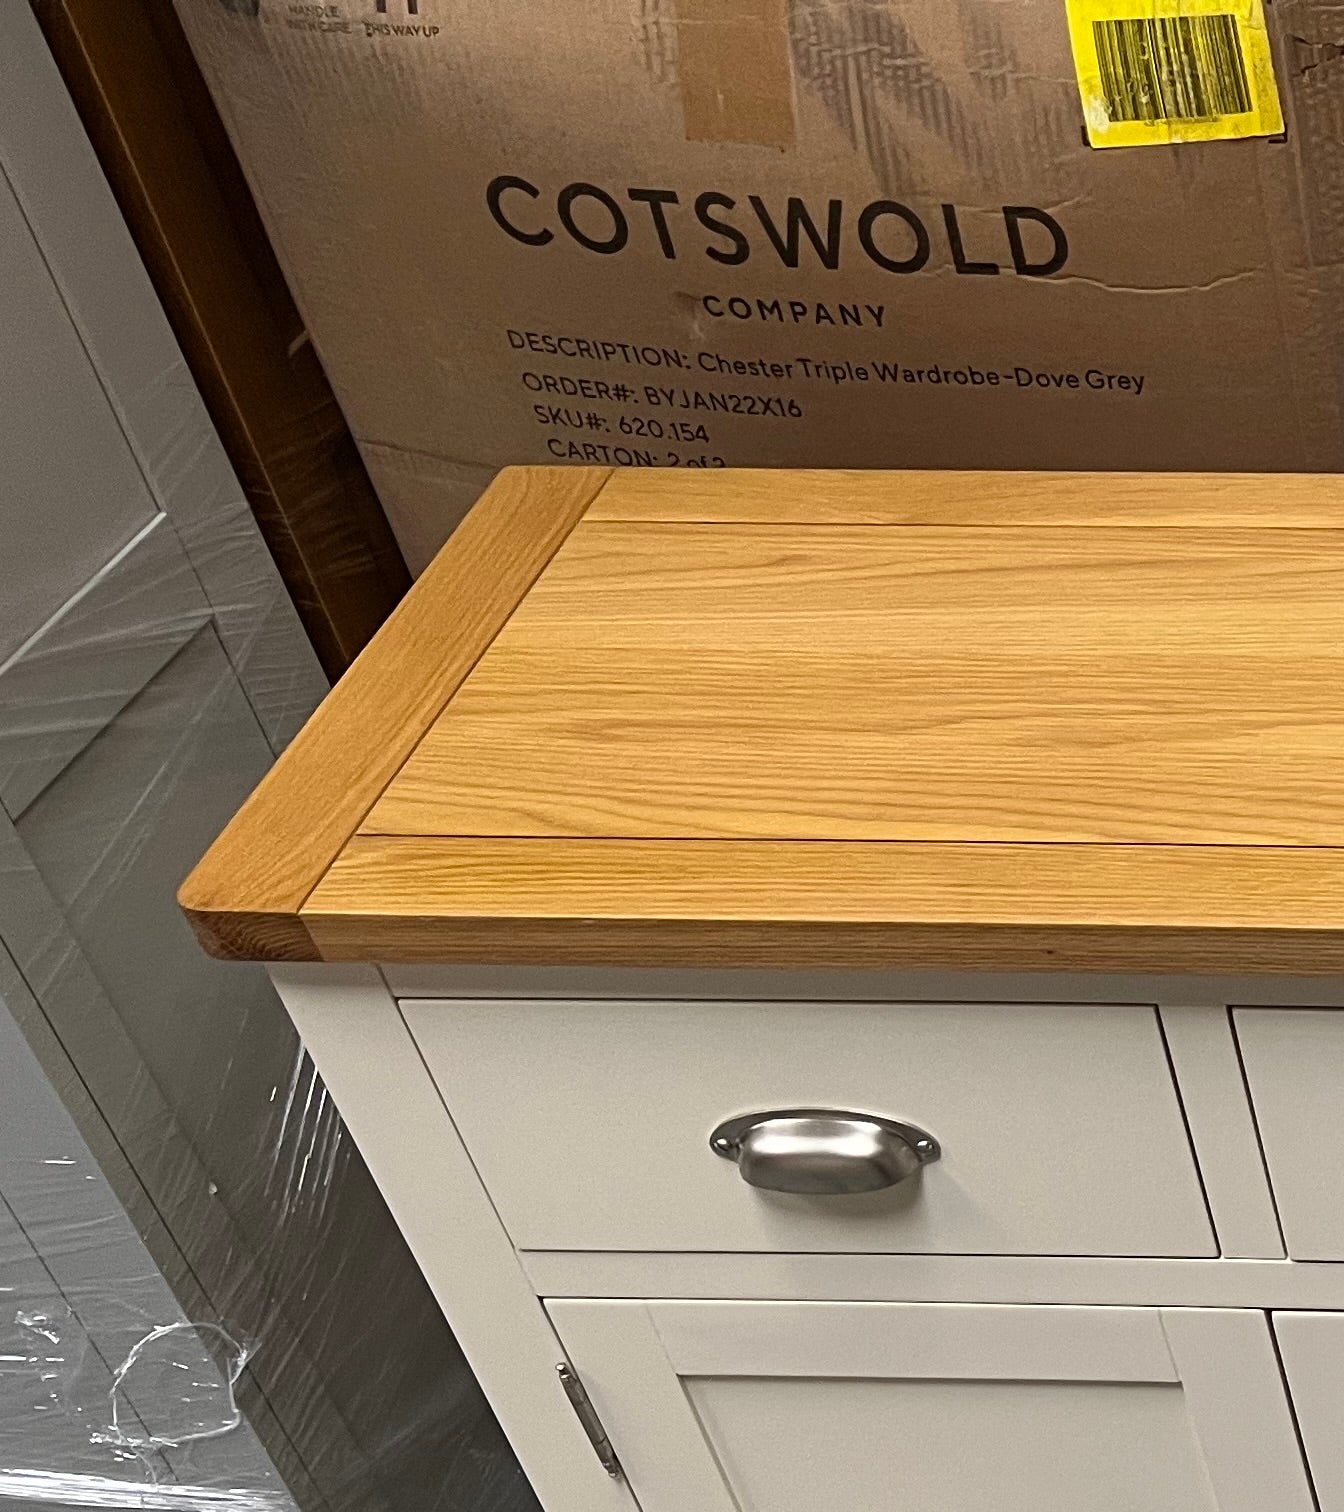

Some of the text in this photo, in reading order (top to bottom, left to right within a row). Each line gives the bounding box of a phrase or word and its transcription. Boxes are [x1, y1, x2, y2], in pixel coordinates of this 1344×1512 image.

[391, 23, 419, 36] WAY
[422, 25, 440, 37] UP
[486, 175, 1069, 276] COTSWOLD
[702, 295, 887, 328] COMPANY
[506, 329, 1146, 395] DESCRIPTION: Chester Triple Wardrobe-Dove Grey
[521, 371, 639, 404] ORDER#:
[533, 404, 710, 443] SKU#: 620.154
